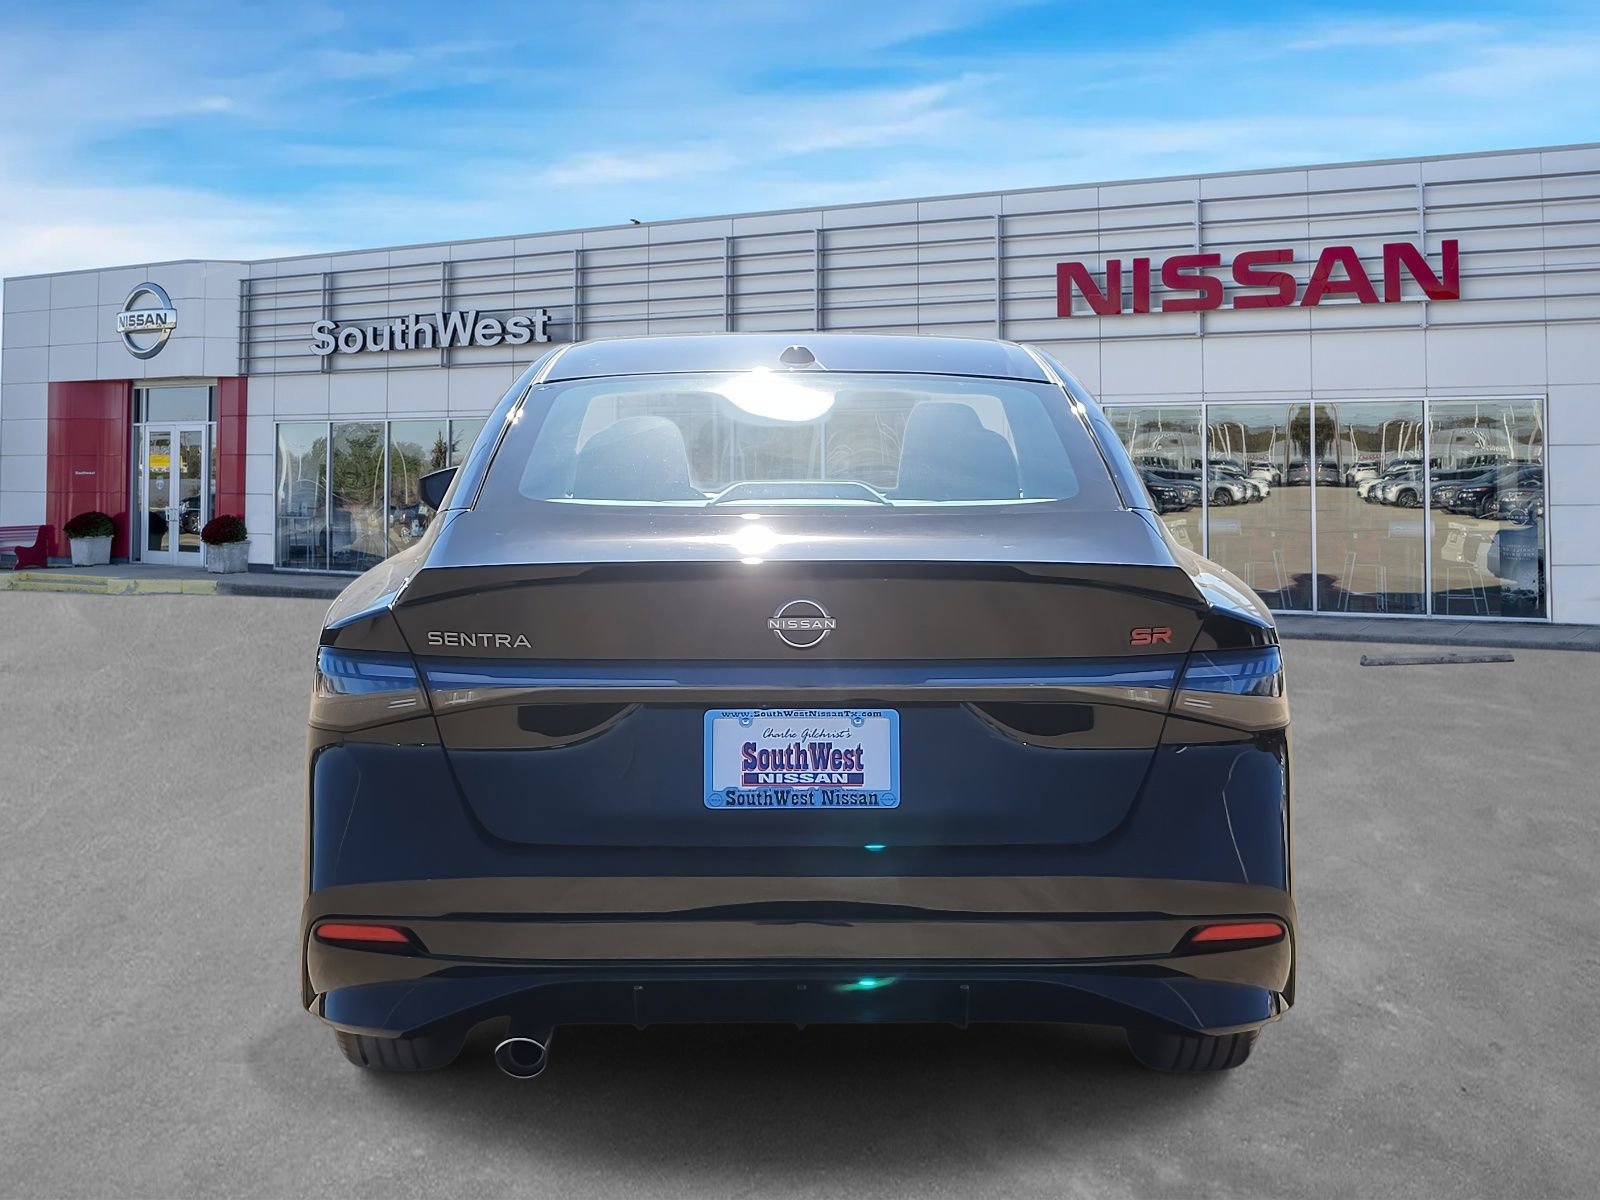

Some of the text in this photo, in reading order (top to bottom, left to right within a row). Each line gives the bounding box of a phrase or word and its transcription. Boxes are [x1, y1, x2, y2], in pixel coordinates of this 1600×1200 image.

[1056, 239, 1460, 318] NISSAN
[119, 312, 168, 328] NISSAN
[309, 308, 551, 356] SouthWest
[769, 619, 836, 629] NISSAN
[427, 631, 532, 648] SENTRA
[1130, 626, 1172, 646] SR
[762, 727, 852, 743] Charlie Gilchrist's
[741, 741, 864, 772] SouthWest
[757, 773, 849, 784] NISSAN
[725, 789, 880, 806] SouthWest Nissan
